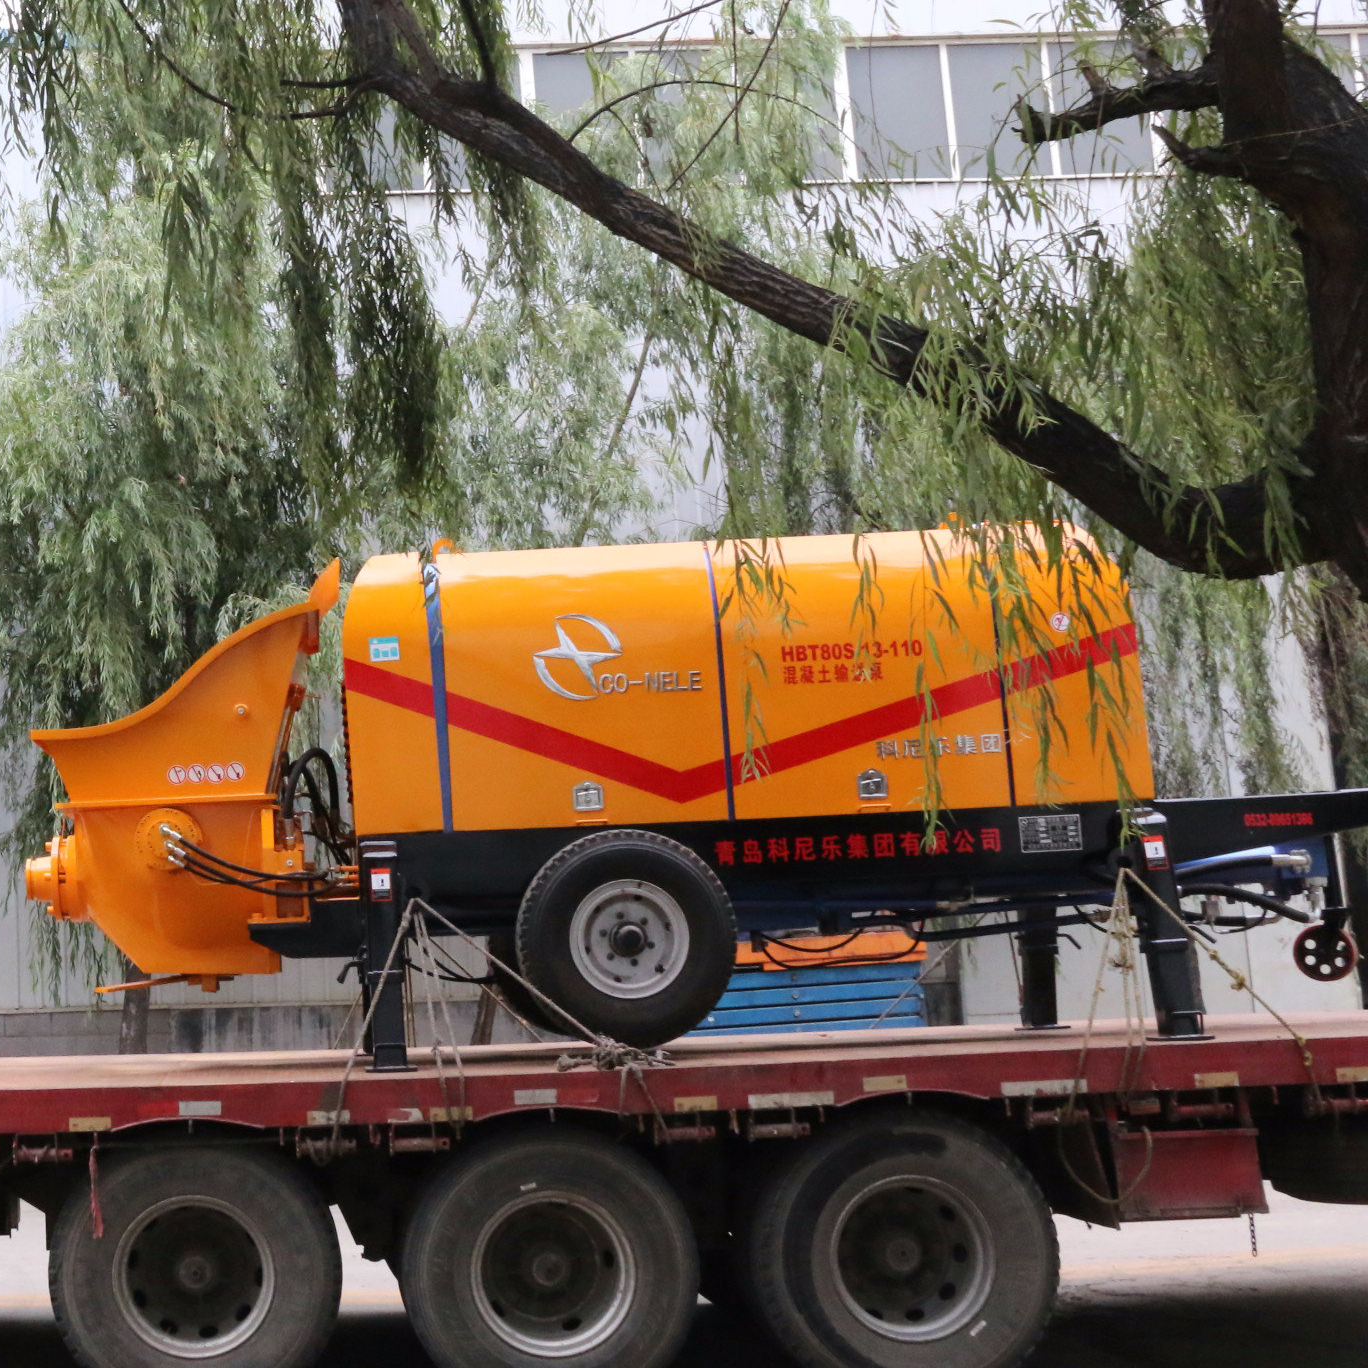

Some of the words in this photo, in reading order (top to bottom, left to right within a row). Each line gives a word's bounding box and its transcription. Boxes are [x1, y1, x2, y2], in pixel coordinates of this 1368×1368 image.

[781, 639, 923, 663] HBT80S13-110
[715, 827, 1002, 866] 青岛科尼乐集团有限公司
